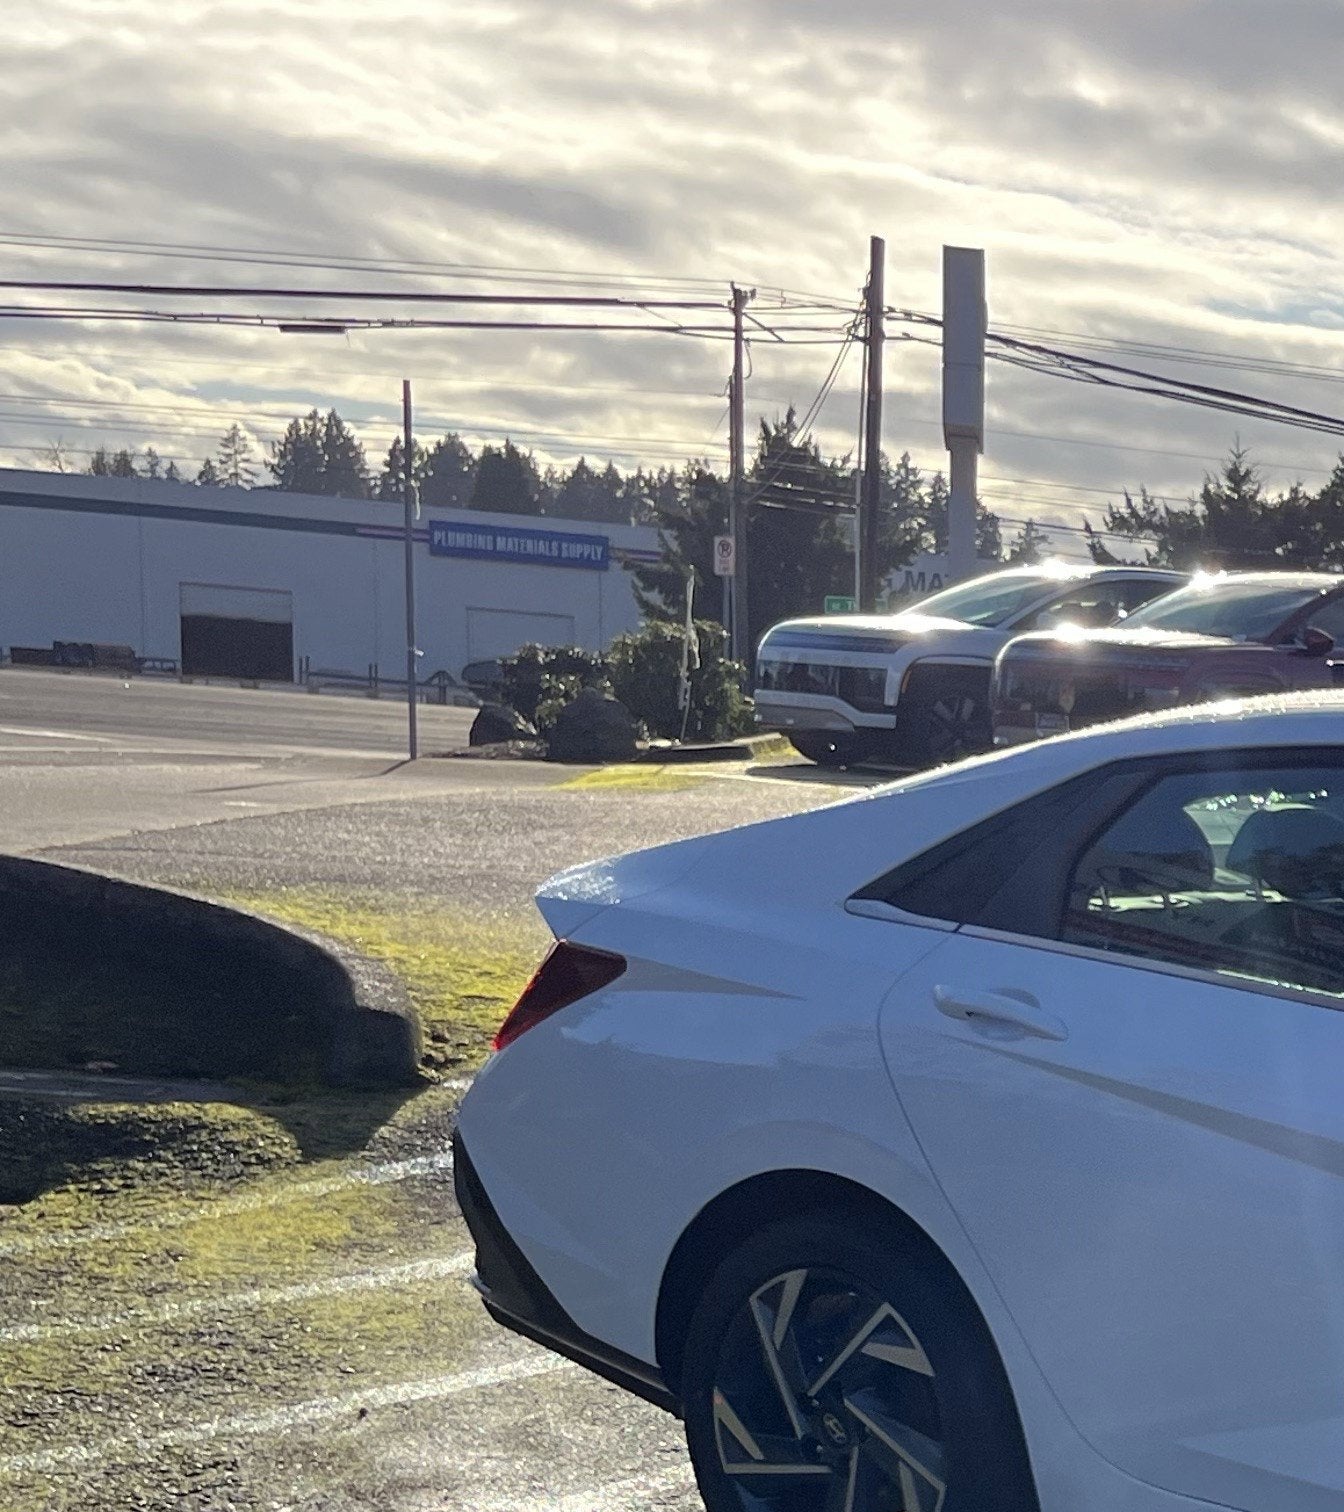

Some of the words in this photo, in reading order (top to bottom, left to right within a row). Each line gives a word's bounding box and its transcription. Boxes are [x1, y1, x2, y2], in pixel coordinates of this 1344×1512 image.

[433, 530, 494, 550] PLUMBING
[496, 536, 559, 557] MATERIALS
[561, 542, 603, 561] SUPPLY
